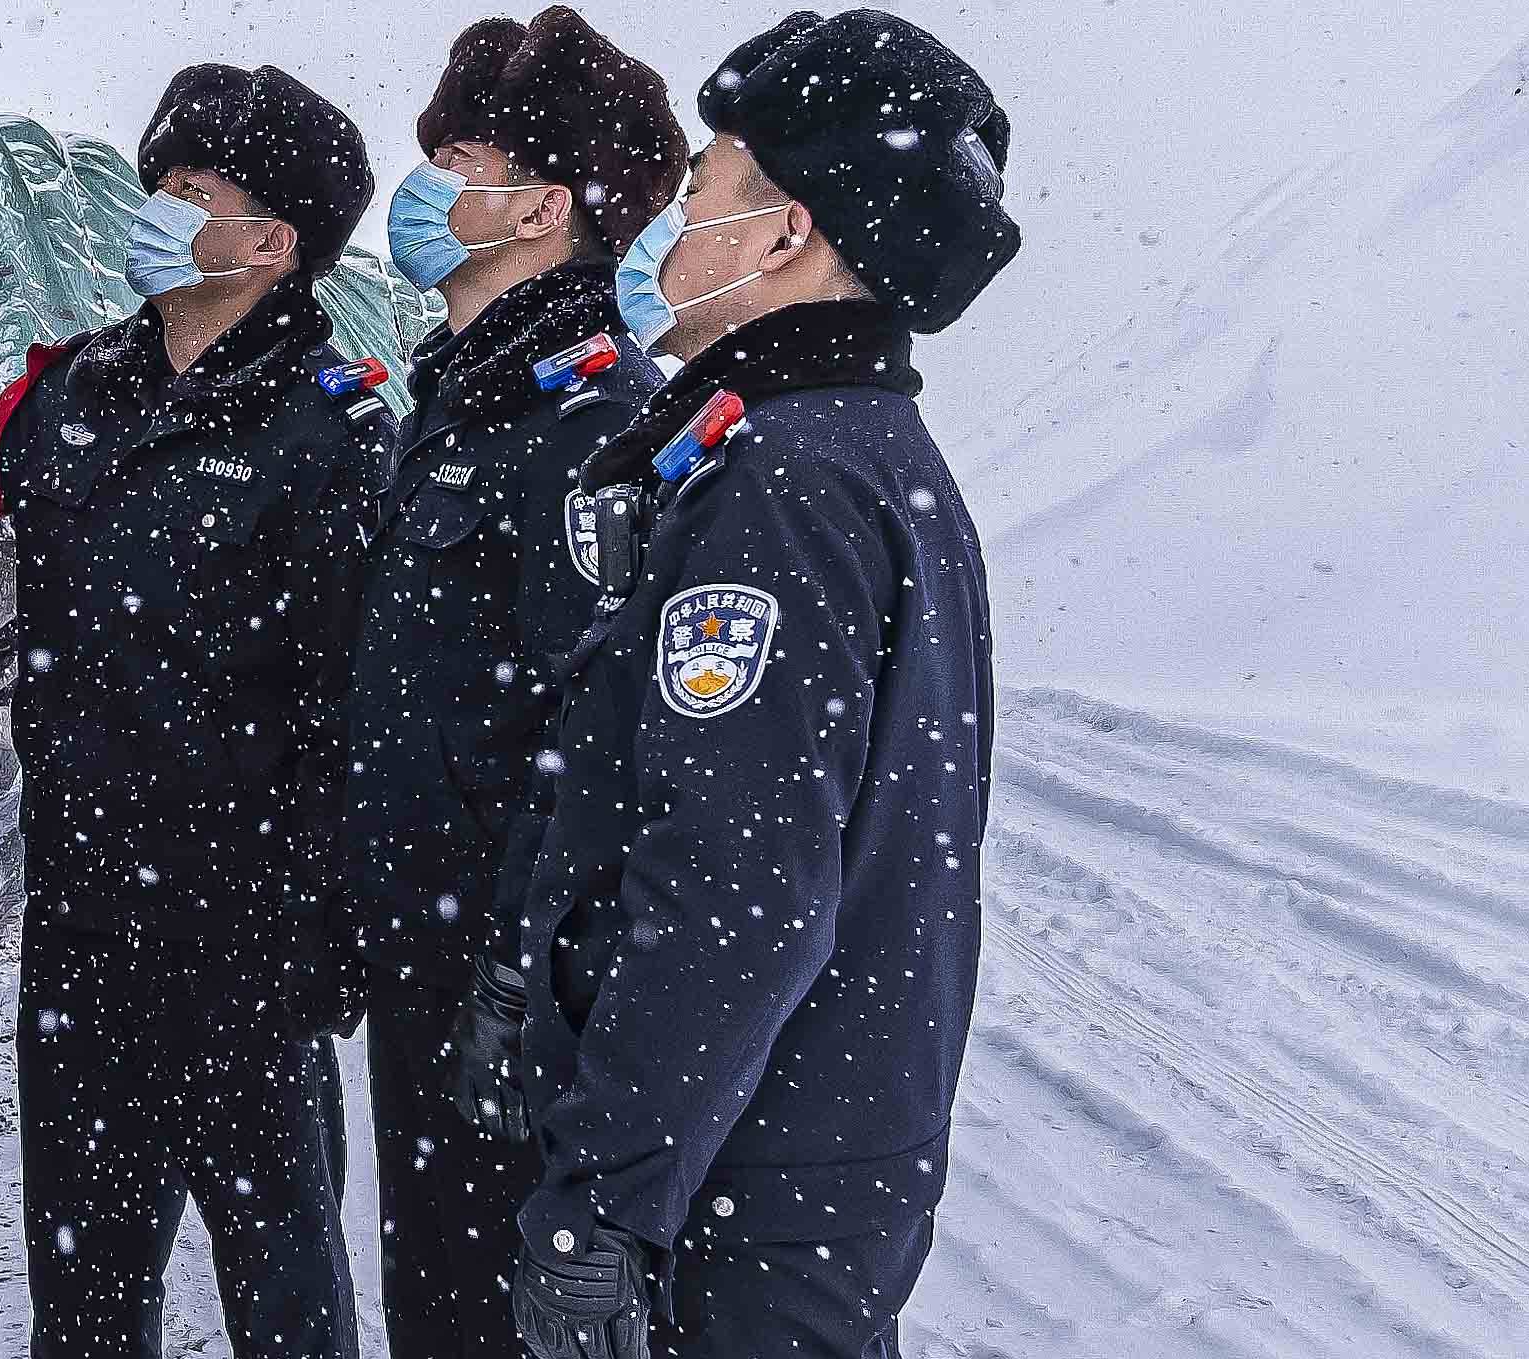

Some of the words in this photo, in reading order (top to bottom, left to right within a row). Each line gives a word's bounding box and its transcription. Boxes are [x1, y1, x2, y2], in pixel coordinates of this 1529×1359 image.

[668, 592, 768, 627] 中华人民共和国
